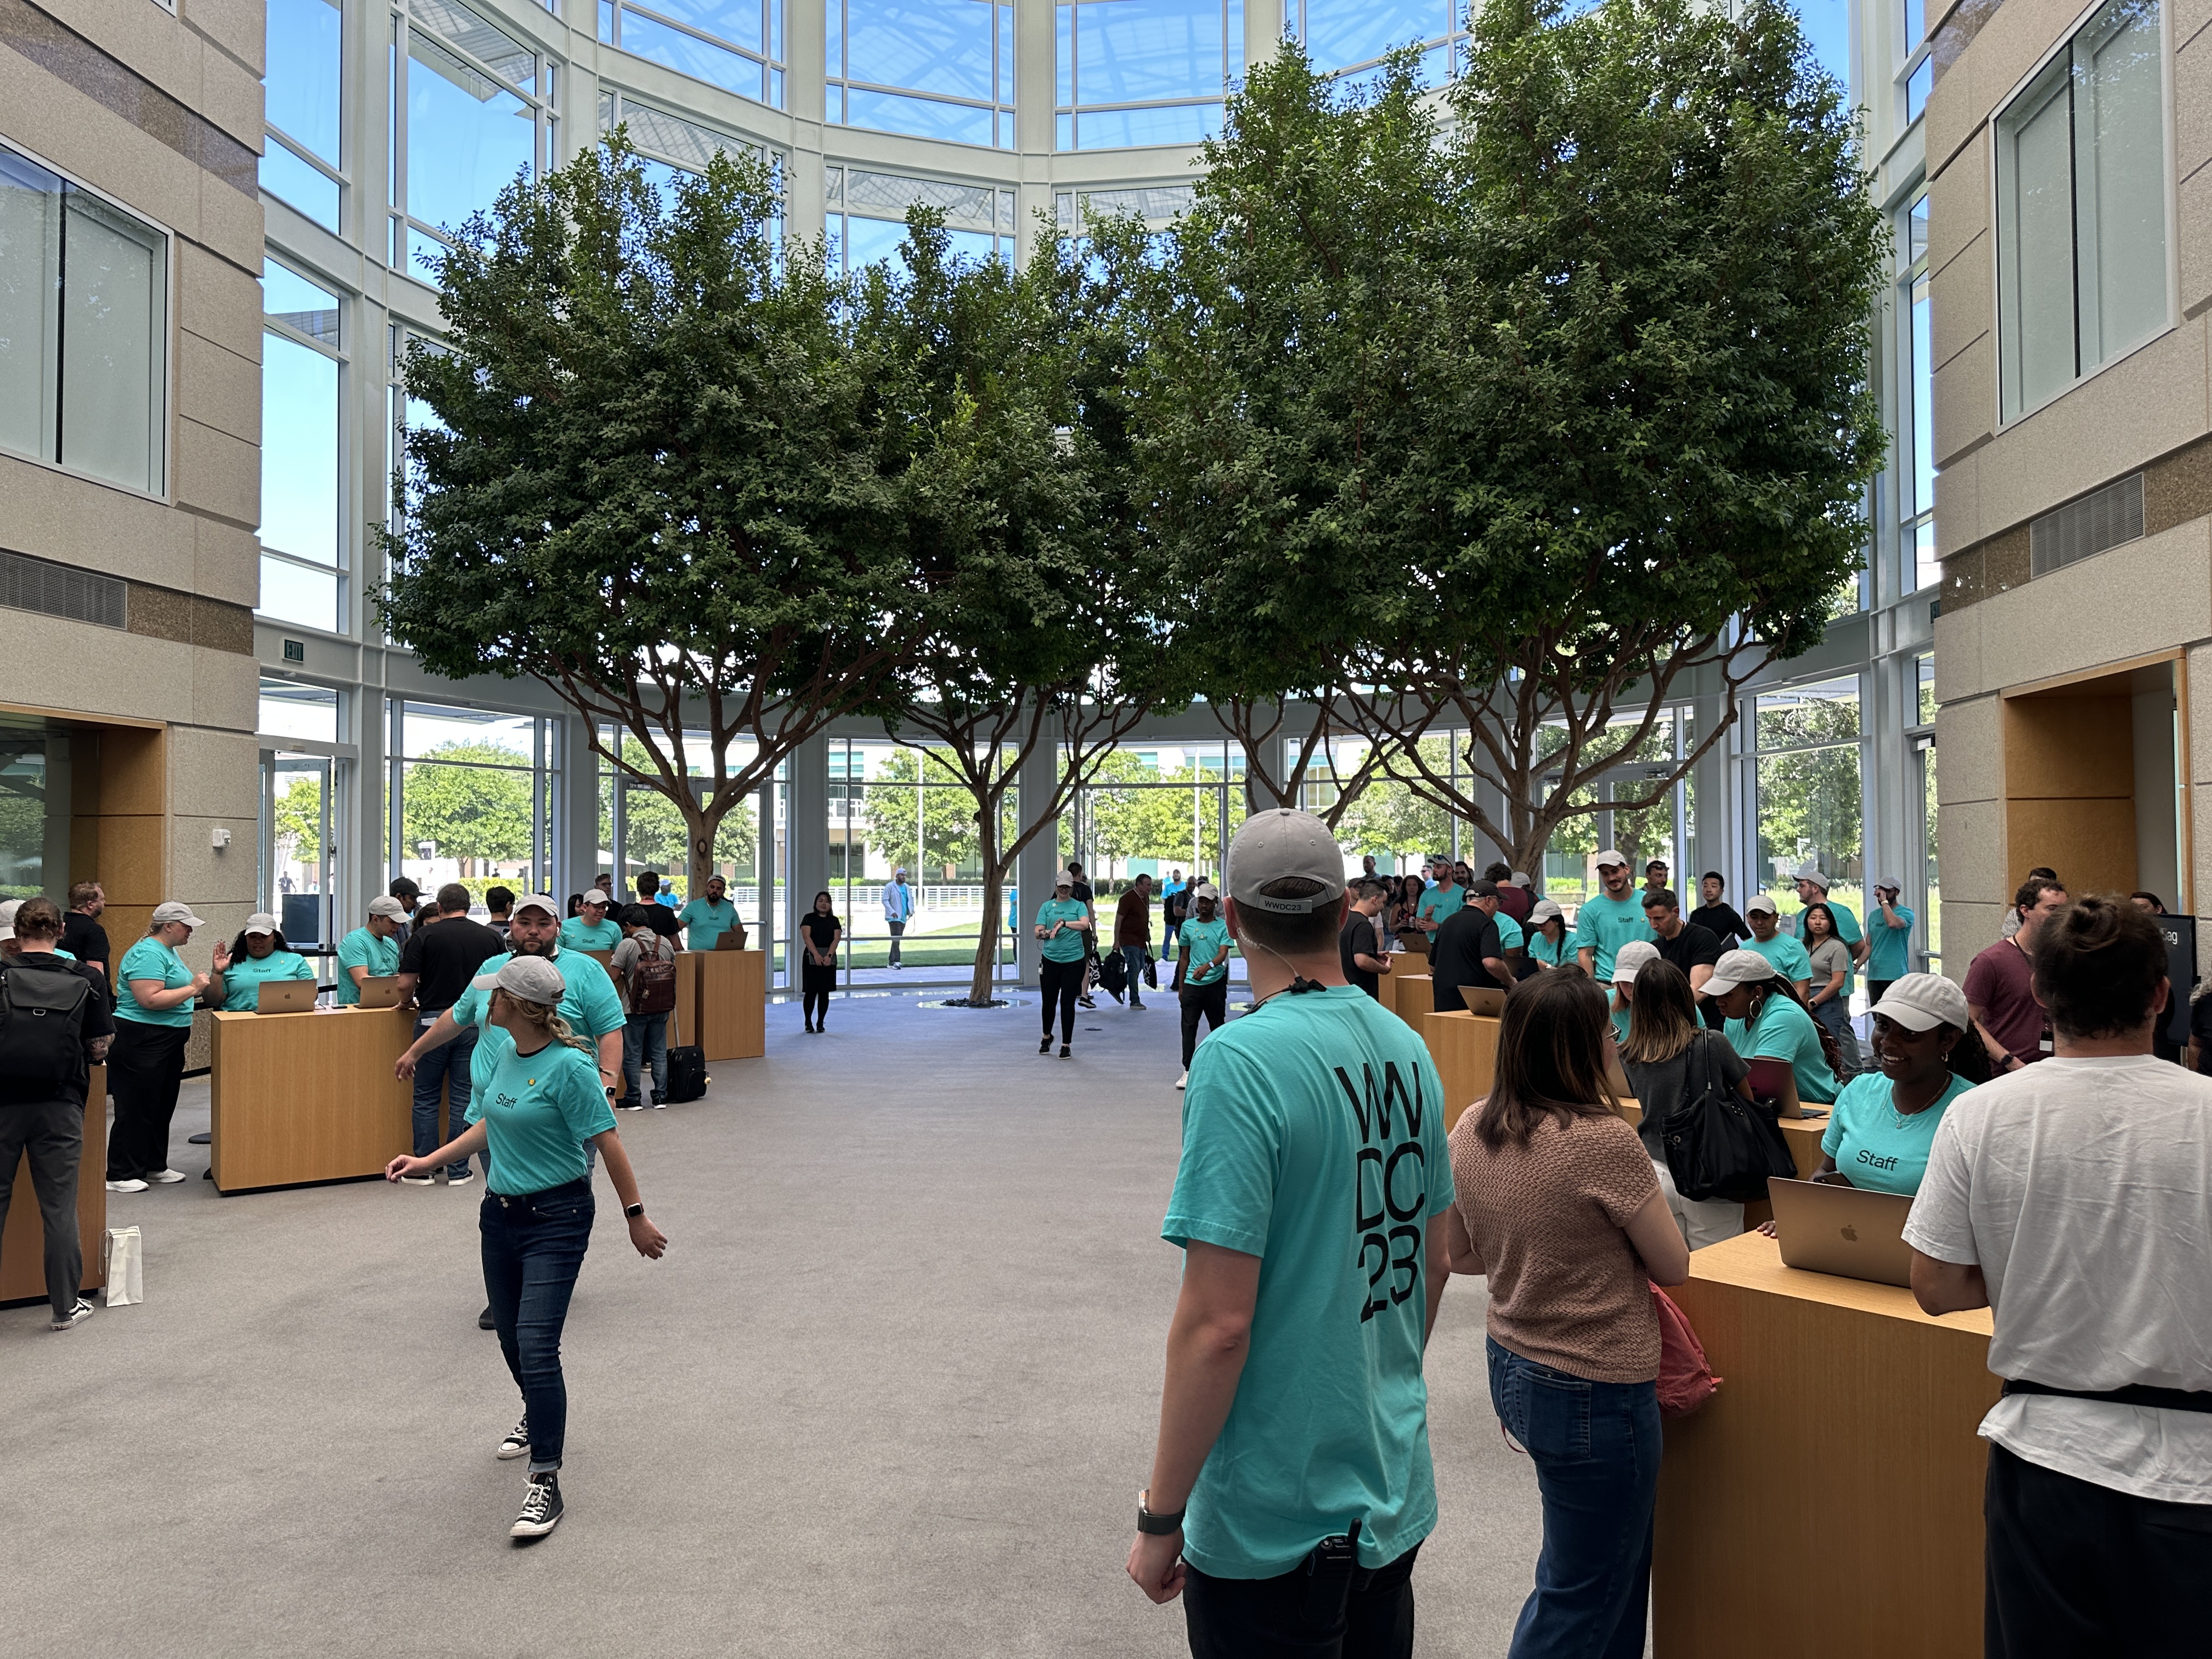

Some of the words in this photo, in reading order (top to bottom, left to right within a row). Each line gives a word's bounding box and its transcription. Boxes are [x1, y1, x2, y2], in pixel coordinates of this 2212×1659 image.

[286, 643, 302, 660] EXIT
[1265, 900, 1301, 911] WWDC23
[496, 1093, 517, 1109] Staff
[1856, 1149, 1898, 1171] Staff
[1357, 1141, 1424, 1234] DC
[1358, 1224, 1420, 1324] 23
